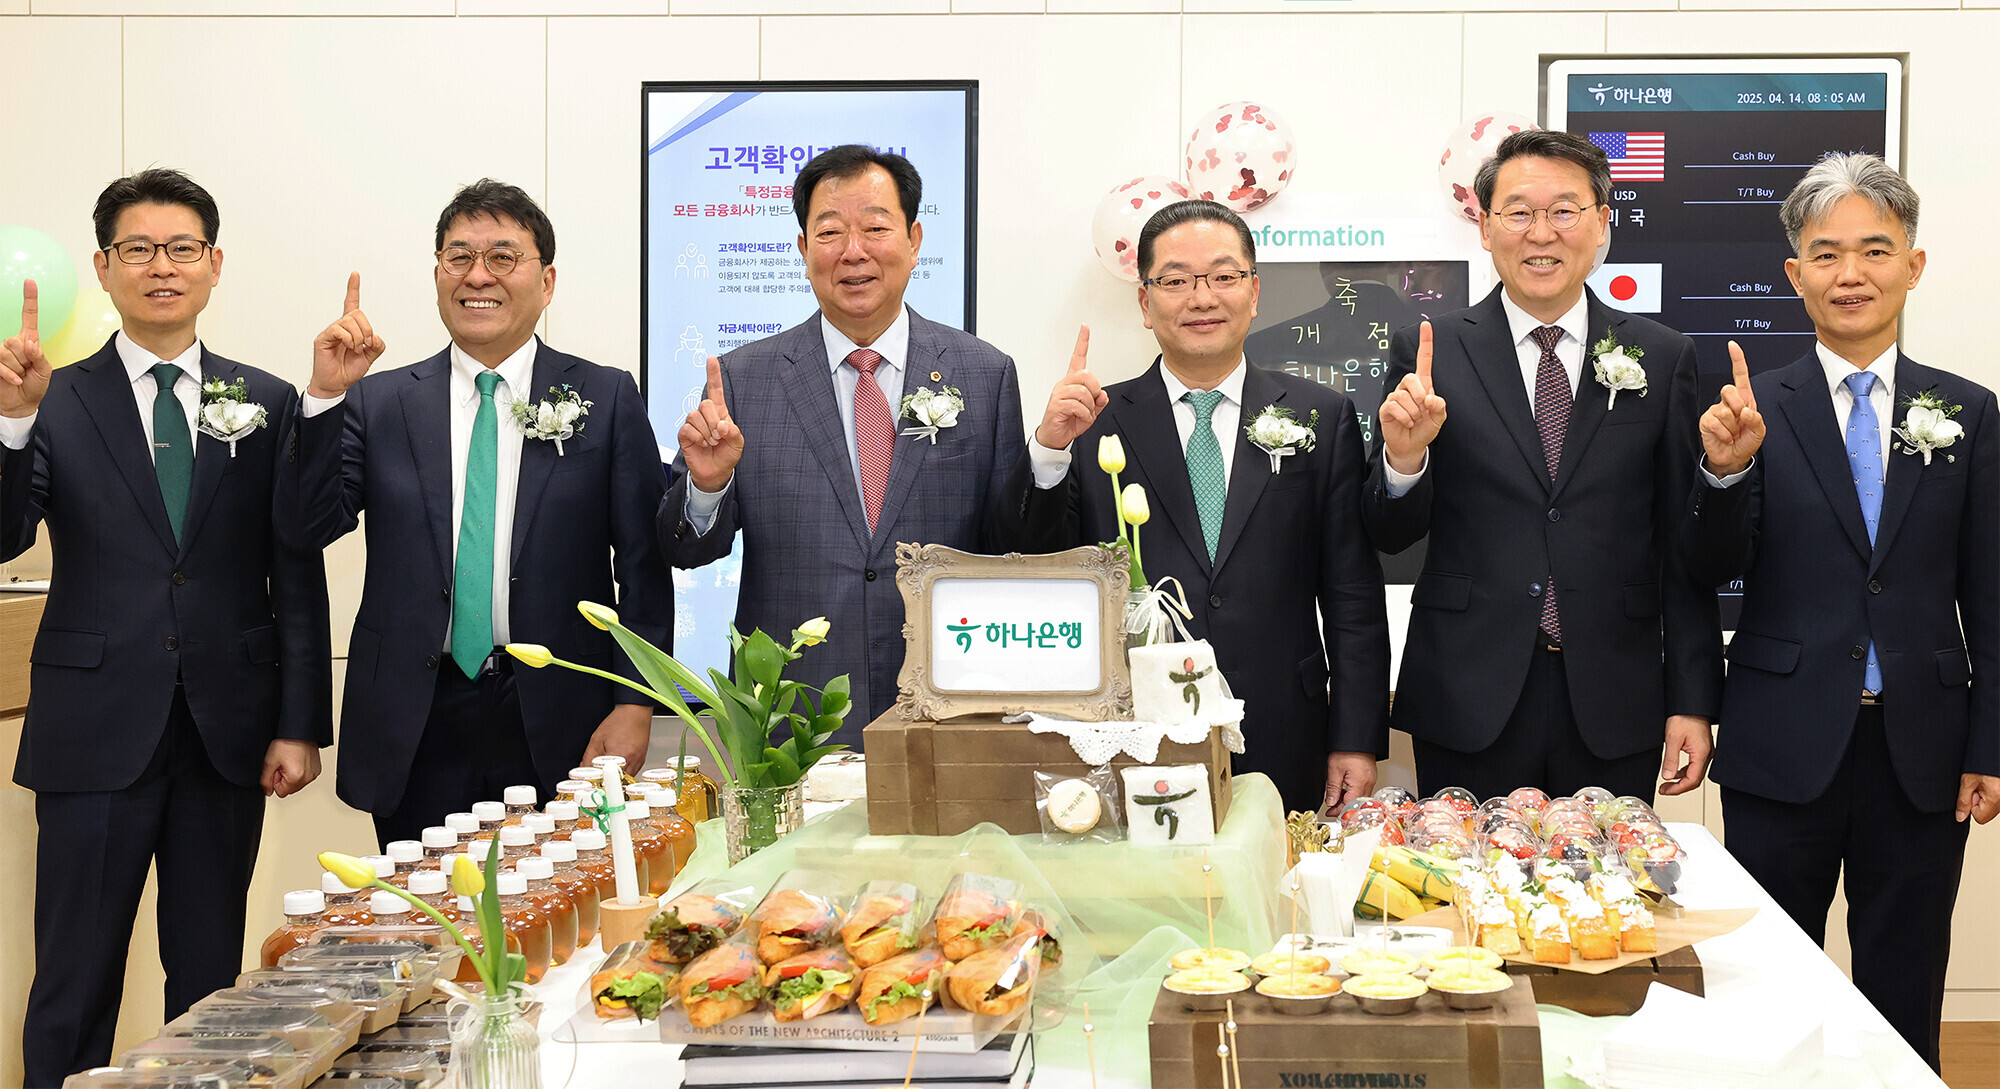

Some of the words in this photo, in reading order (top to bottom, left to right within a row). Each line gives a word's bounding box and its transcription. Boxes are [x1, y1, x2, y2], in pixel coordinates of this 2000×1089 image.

[1613, 87, 1672, 105] 하나은행
[1737, 93, 1766, 104] 2025.
[1769, 93, 1785, 104] 04.
[1789, 93, 1805, 104] 14.
[1808, 93, 1820, 104] 08
[1830, 93, 1842, 104] 05
[1846, 93, 1866, 104] AM
[1732, 151, 1754, 162] Cash
[1755, 151, 1775, 163] Buy
[1614, 190, 1637, 201] USD
[1737, 188, 1753, 198] T/T
[1756, 188, 1775, 199] Buy
[673, 204, 698, 217] 모든
[704, 204, 766, 218] 금융회사가
[718, 242, 792, 253] 고객확인제도란?
[718, 257, 757, 267] 금융회사가
[759, 257, 791, 267] 제공하는
[718, 271, 750, 280] 이용되지
[777, 271, 801, 280] 고객의
[922, 271, 931, 280] 등
[718, 285, 741, 294] 고객에
[744, 285, 760, 294] 대해
[762, 285, 786, 294] 합당한
[788, 285, 811, 294] 주의를
[1729, 283, 1751, 294] Cash
[1752, 283, 1772, 295] Buy
[1335, 277, 1358, 315] 축
[718, 323, 782, 334] 자금세탁이란?
[1734, 319, 1751, 330] T/T
[1753, 319, 1771, 330] Buy
[1291, 323, 1320, 344] 개
[1367, 322, 1389, 349] 점
[986, 621, 1082, 649] 하나은행
[729, 1025, 745, 1036] OF
[748, 1026, 769, 1037] THE
[773, 1027, 801, 1038] NEW
[805, 1028, 889, 1042] ARCHITECTURE
[893, 1031, 900, 1042] 2
